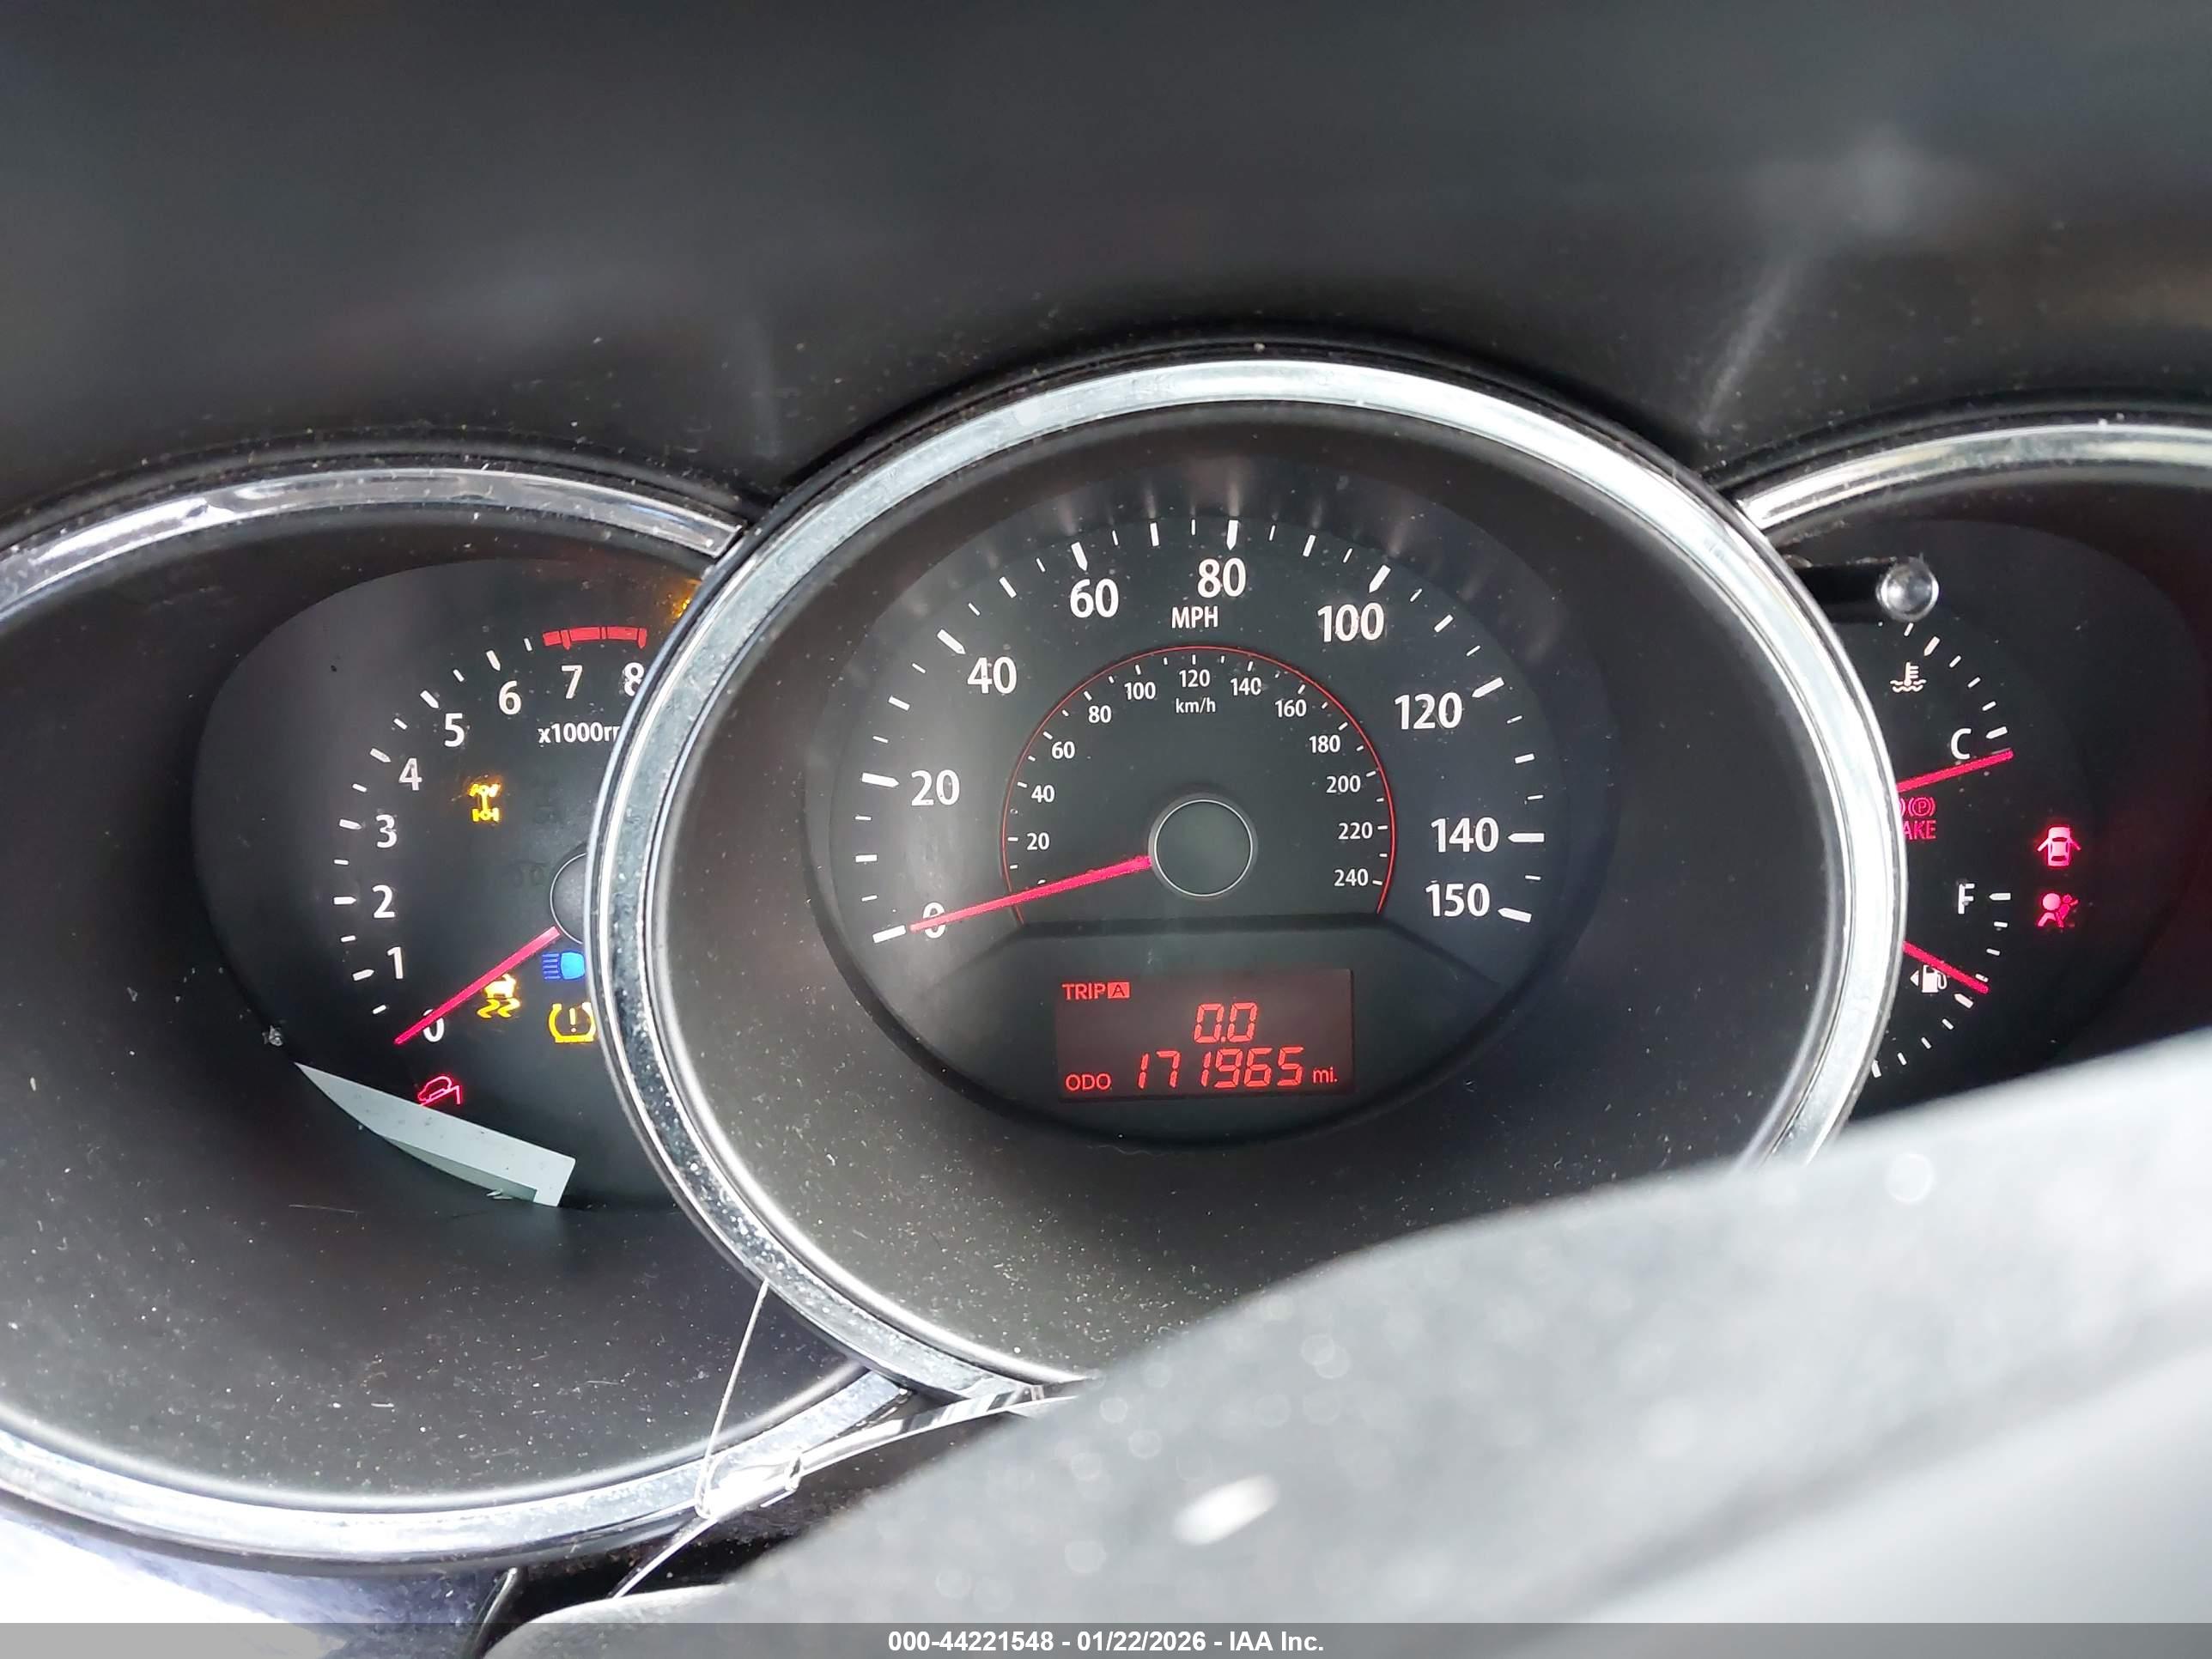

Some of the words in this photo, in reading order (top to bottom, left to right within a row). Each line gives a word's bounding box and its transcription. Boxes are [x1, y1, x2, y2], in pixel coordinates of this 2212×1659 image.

[1197, 557, 1246, 598] 80
[1070, 579, 1119, 617] 60
[1171, 606, 1218, 629] MPH
[1317, 603, 1384, 642] 100
[561, 665, 583, 699] 7
[624, 662, 645, 697] 8
[967, 657, 1018, 694] 40
[1124, 682, 1156, 700] 100
[1179, 669, 1211, 688] 120
[1230, 677, 1262, 696] 140
[498, 681, 522, 715] 6
[1176, 697, 1217, 714] km/h
[1274, 699, 1307, 718] 160
[1395, 692, 1463, 730] 120
[444, 713, 466, 747] 5
[1088, 706, 1112, 724] 80
[1051, 741, 1076, 759] 60
[1309, 734, 1341, 753] 180
[1950, 727, 1972, 760] C
[398, 757, 422, 791] 4
[911, 769, 960, 806] 20
[1326, 775, 1361, 793] 200
[1030, 784, 1055, 803] 40
[375, 814, 398, 848] 3
[1026, 833, 1050, 850] 20
[1338, 822, 1373, 839] 220
[1431, 817, 1499, 853] 140
[1334, 869, 1369, 887] 240
[372, 884, 396, 919] 2
[1425, 884, 1491, 917] 150
[1957, 883, 1975, 915] F
[386, 946, 404, 980] 1
[1061, 982, 1106, 1000] TRIP
[1194, 1002, 1258, 1043] 0.0
[1065, 1073, 1112, 1091] ODO
[1137, 1046, 1304, 1090] 171965
